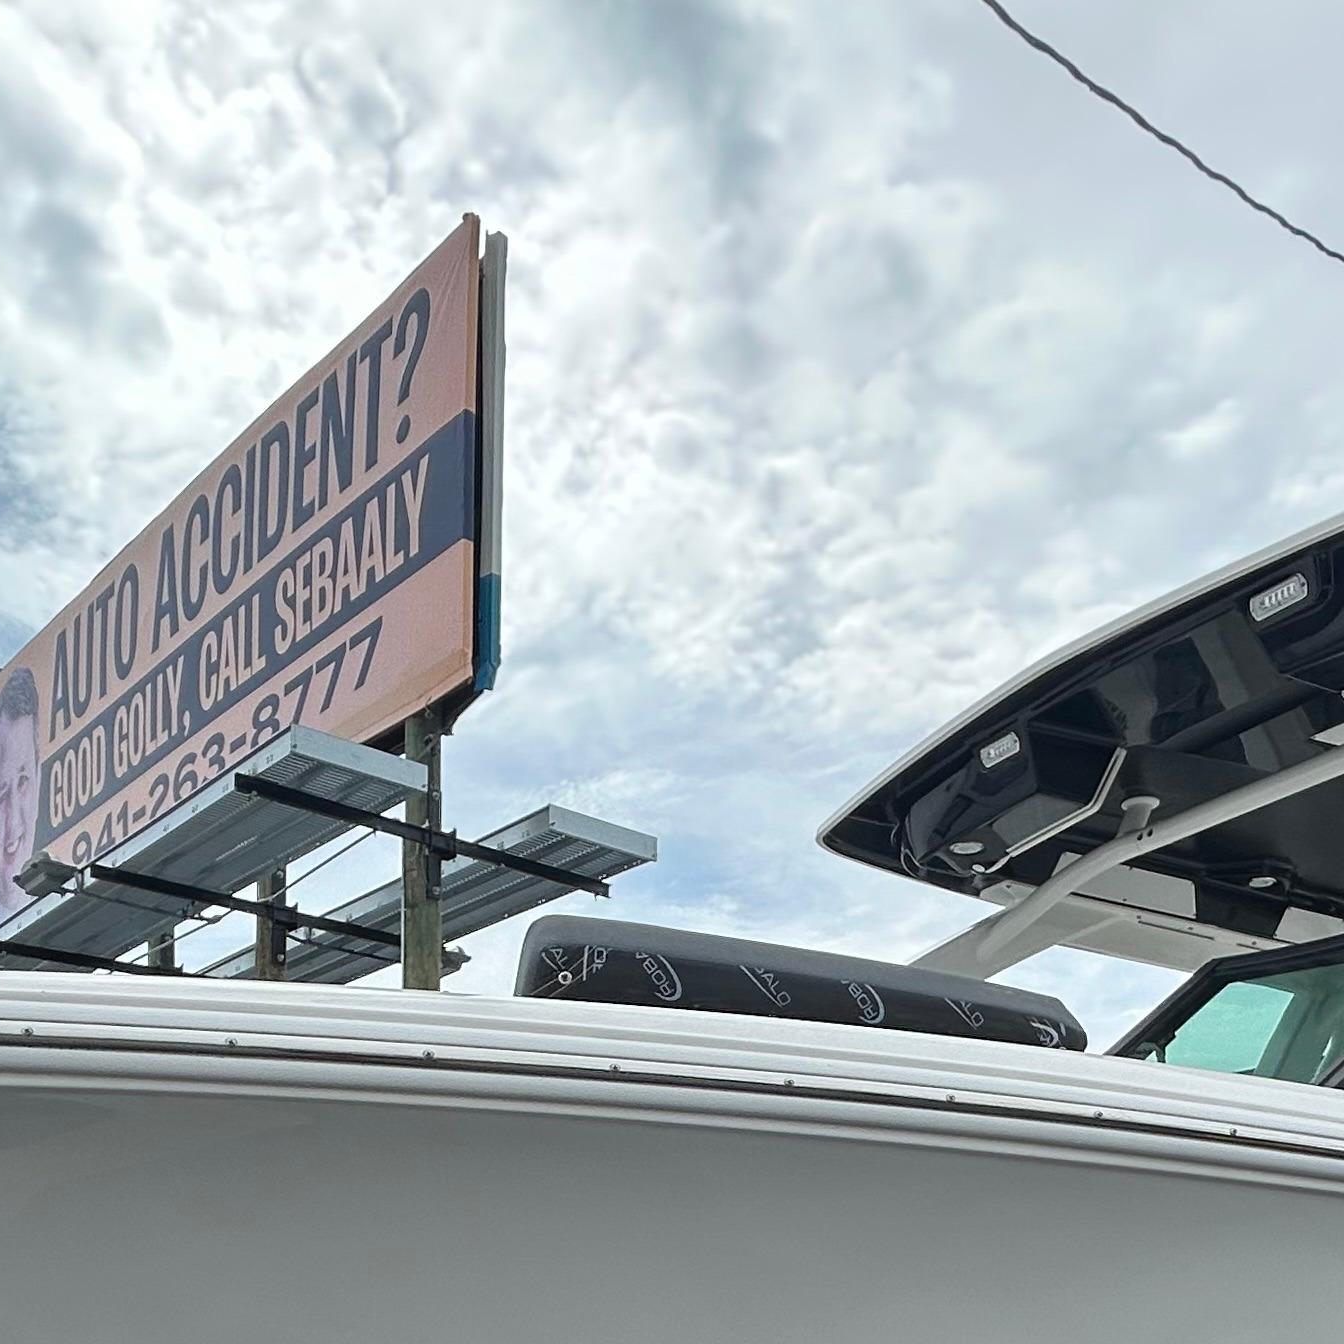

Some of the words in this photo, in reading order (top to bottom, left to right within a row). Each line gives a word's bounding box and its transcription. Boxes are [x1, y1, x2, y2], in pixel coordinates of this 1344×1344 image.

[49, 564, 140, 743] AUTO
[152, 287, 431, 653] ACCIDENT?
[49, 725, 106, 828] GOOD
[113, 655, 191, 778] GOLLY,
[199, 593, 266, 711] CALL
[274, 453, 430, 656] SEBAALY
[72, 615, 383, 866] 941-263-8777
